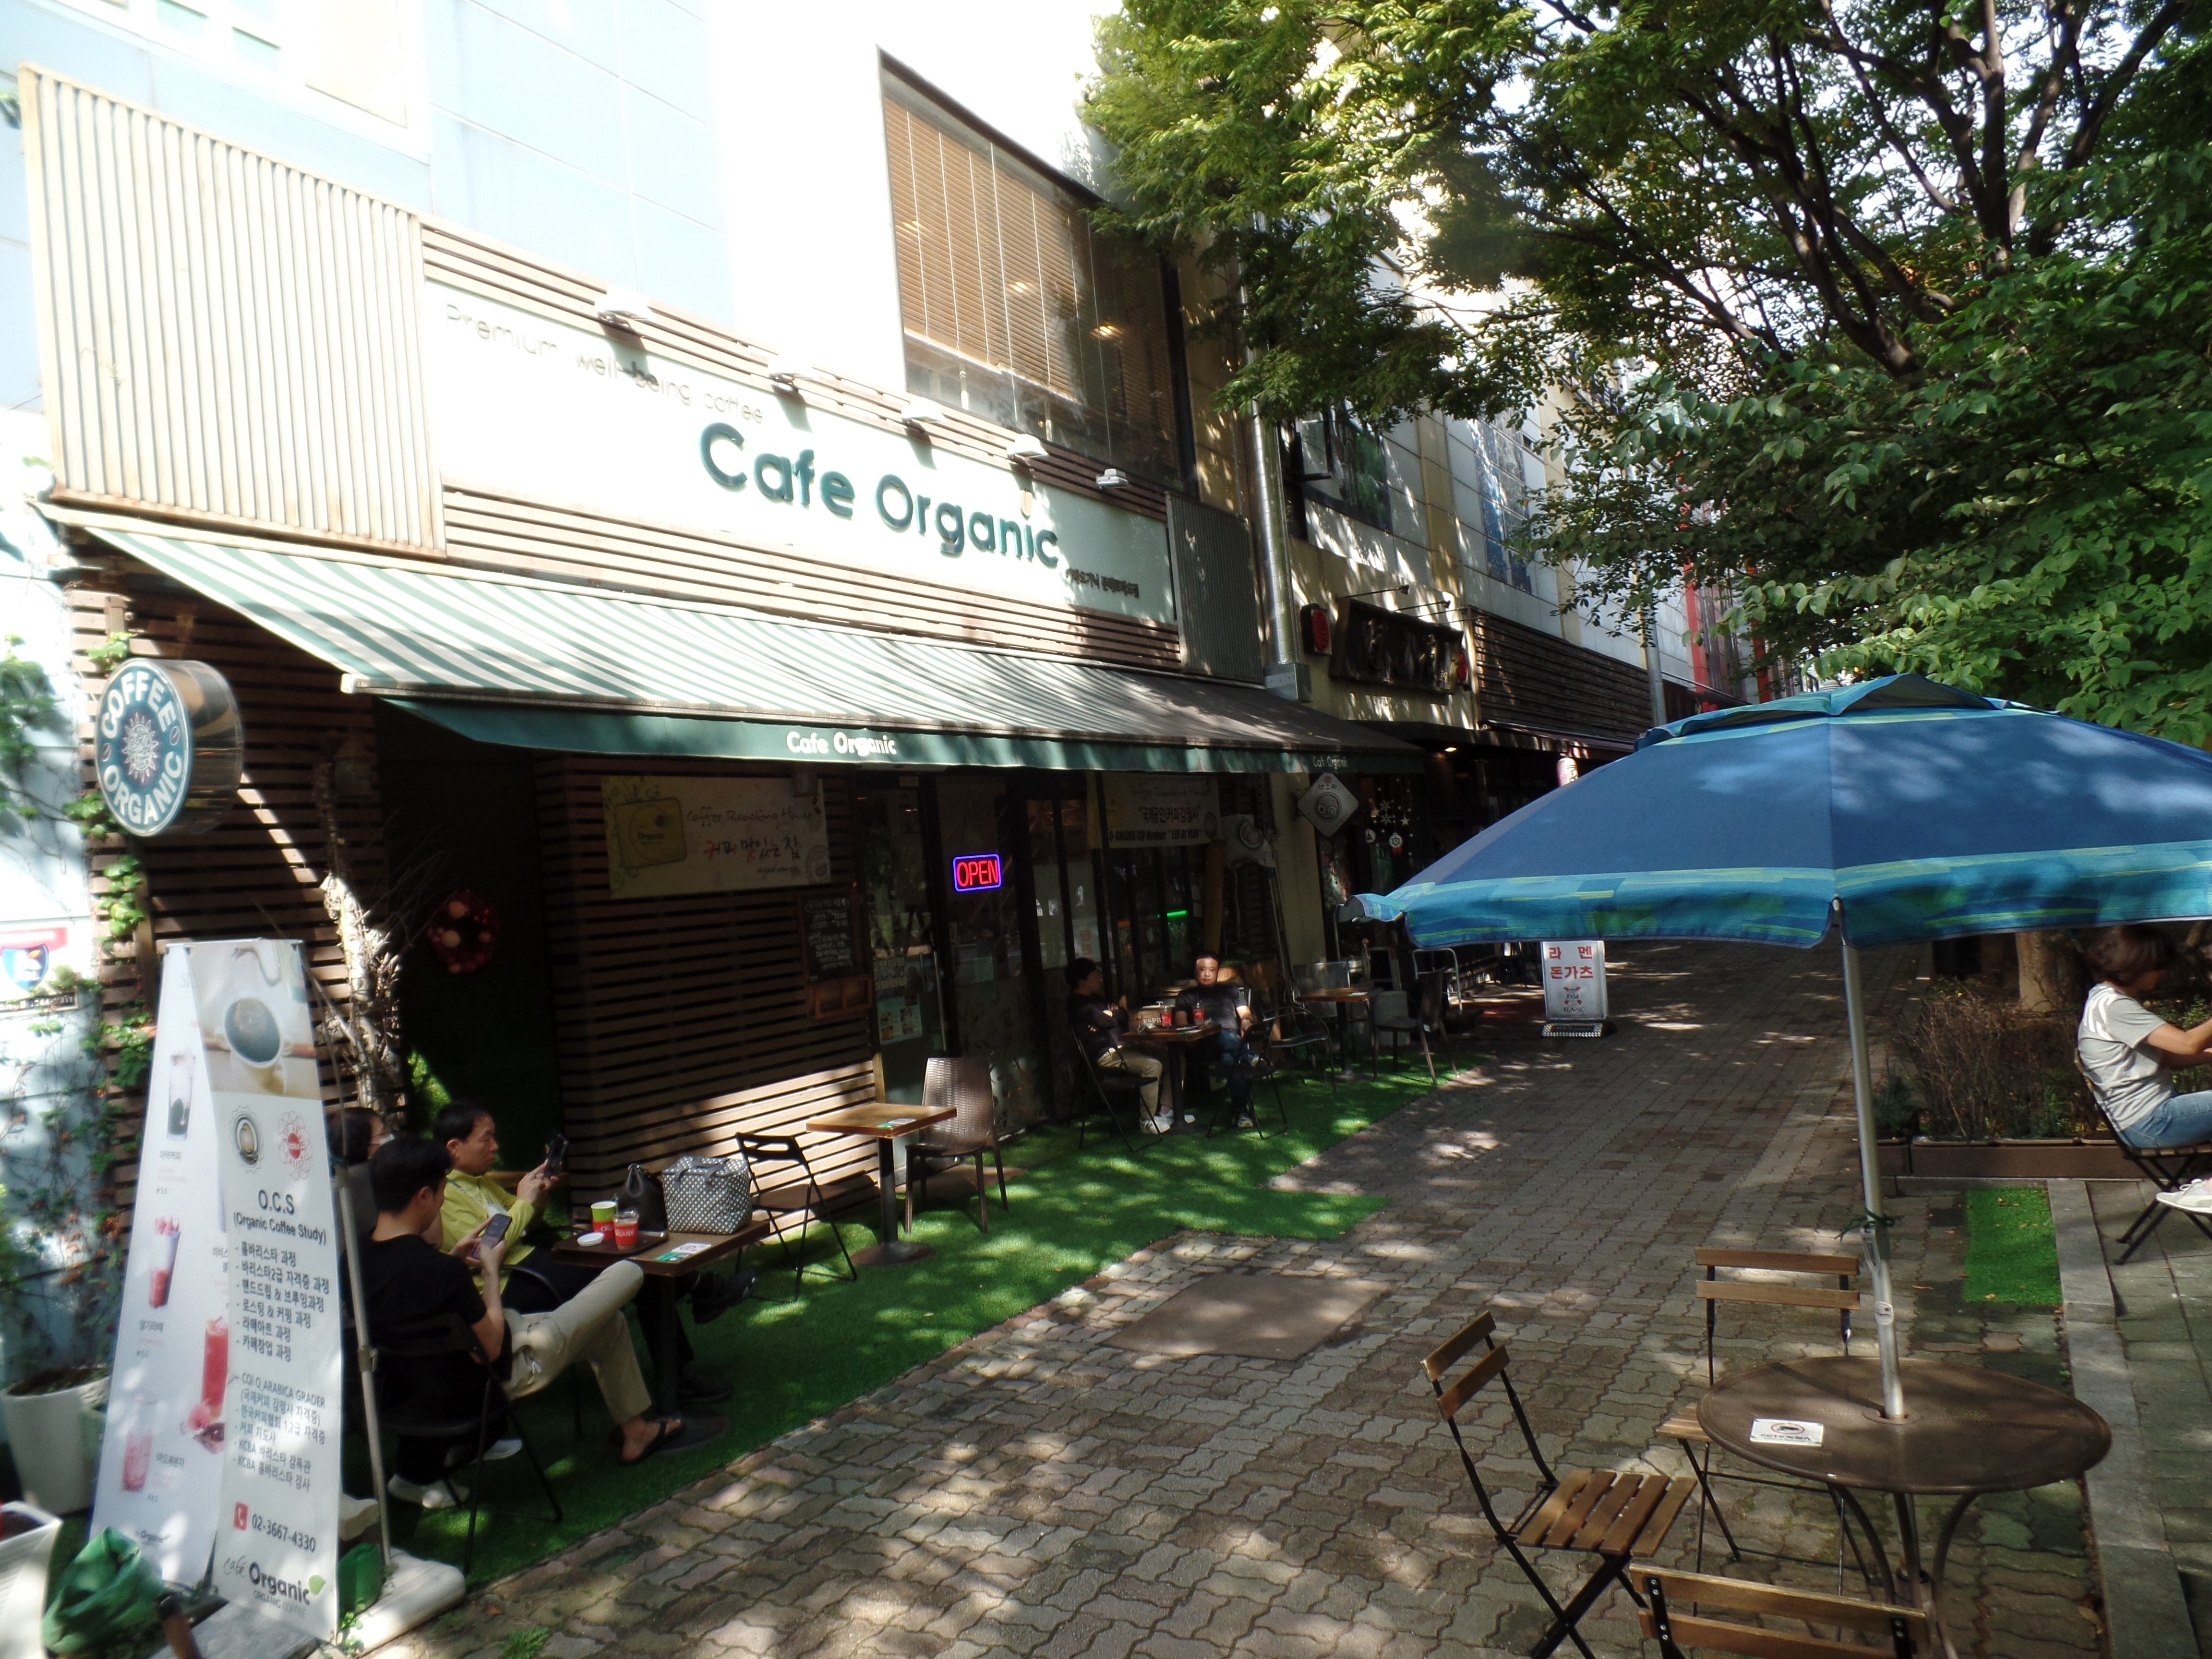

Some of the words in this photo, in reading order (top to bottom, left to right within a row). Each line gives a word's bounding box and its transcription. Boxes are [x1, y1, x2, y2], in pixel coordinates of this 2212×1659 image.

[445, 302, 559, 360] Premium
[575, 352, 691, 406] well-being
[699, 422, 855, 518] Cafe
[874, 474, 1058, 567] Organic
[101, 671, 178, 739] COFFEE
[786, 731, 829, 755] Cafe
[833, 731, 897, 756] Organic
[103, 751, 182, 825] ORGANIC
[687, 802, 722, 826] Coffee
[725, 804, 779, 824] Roasting
[704, 834, 737, 856] 커피
[740, 832, 781, 859] 맛있는
[783, 830, 801, 856] 집
[956, 859, 999, 888] OPEN
[1550, 966, 1594, 979] 돈가츠
[258, 1189, 295, 1215] O.C.S
[234, 1211, 267, 1231] (Organic
[269, 1218, 296, 1237] Coffee
[298, 1223, 327, 1246] Study)
[280, 1250, 297, 1268] 과정
[241, 1260, 283, 1284] 바리스타2급
[286, 1270, 309, 1291] 자격증
[313, 1276, 329, 1295] 과정
[241, 1277, 271, 1300] 핸드드립
[274, 1287, 281, 1301] &
[242, 1298, 264, 1317] 로스팅
[266, 1305, 274, 1319] &
[276, 1306, 292, 1324] 커핑
[295, 1311, 311, 1329] 과정
[242, 1316, 273, 1336] 라떼아트
[276, 1325, 291, 1343] 과정
[242, 1334, 273, 1357] 카페창업
[275, 1344, 291, 1363] 과정
[263, 1379, 294, 1399] ARABICA
[295, 1389, 325, 1409] GRADER
[240, 1421, 253, 1438] 커피
[237, 1454, 256, 1471] KCBA
[238, 1438, 257, 1455] KCBA
[259, 1445, 287, 1467] 바리스타
[252, 1513, 317, 1552] 02-3667-4330
[248, 1561, 311, 1606] Organic
